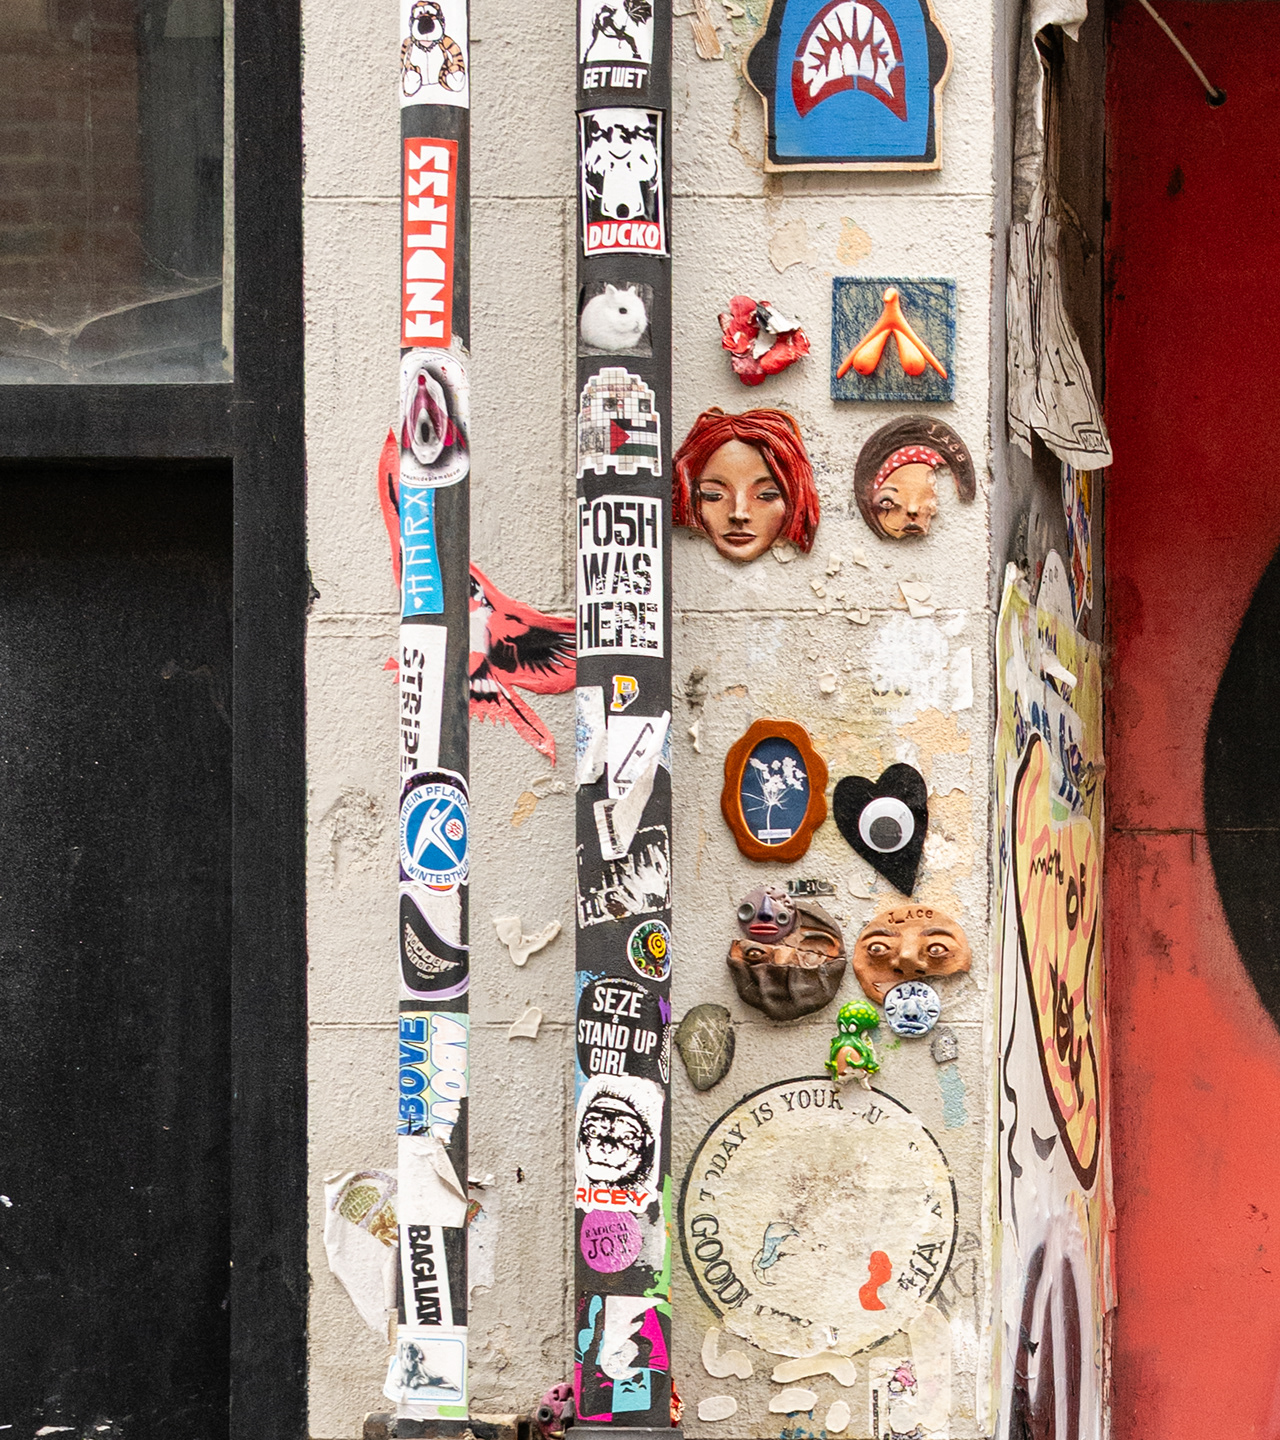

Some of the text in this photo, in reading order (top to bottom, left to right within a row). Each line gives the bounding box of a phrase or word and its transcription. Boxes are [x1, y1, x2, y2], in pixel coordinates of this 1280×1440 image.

[583, 67, 647, 90] GET WET
[405, 145, 450, 338] ENDLESS
[588, 222, 660, 249] DUCKO
[583, 553, 652, 596] WAS
[579, 601, 658, 650] HERE
[592, 986, 644, 1019] SEZE
[611, 1014, 620, 1024] &
[577, 1018, 658, 1055] STAND UP
[589, 1047, 630, 1076] GIRL
[750, 1102, 774, 1128] IS
[780, 1088, 844, 1114] YOUR
[576, 1187, 649, 1207] RICEY
[690, 1212, 753, 1310] GOOD
